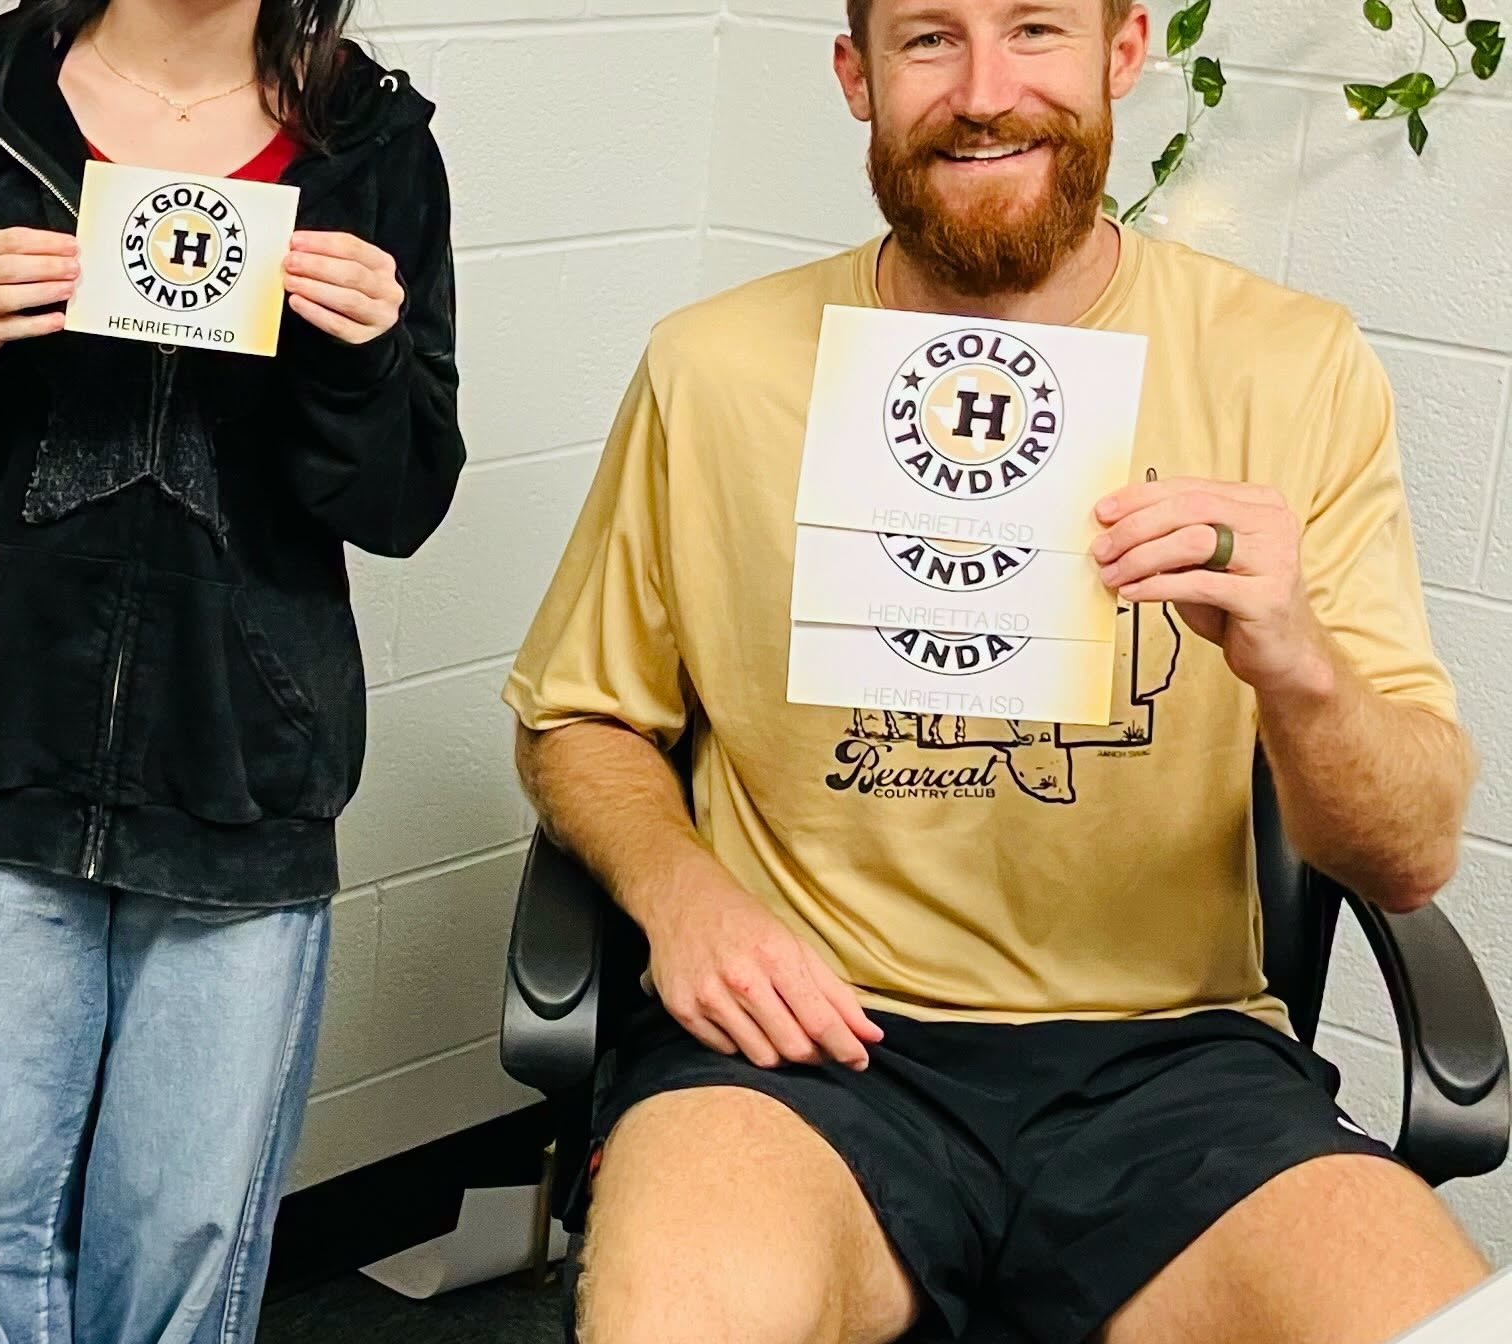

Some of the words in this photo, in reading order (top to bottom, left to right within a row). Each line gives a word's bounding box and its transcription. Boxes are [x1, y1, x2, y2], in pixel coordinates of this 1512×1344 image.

[151, 188, 228, 222] GOLD
[169, 228, 211, 269] H
[125, 233, 243, 309] STANDARD
[108, 315, 204, 341] HENRIETTA
[207, 327, 236, 344] ISD
[925, 334, 1037, 379] GOLD
[951, 390, 1011, 442] H
[890, 398, 1057, 495] STANDARD
[872, 506, 994, 539] HENRIETTA
[998, 523, 1034, 544] ISD
[867, 603, 989, 633] HENRIETTA
[994, 613, 1030, 634] ISD
[862, 686, 985, 714] HENRIETTA
[989, 696, 1025, 716] ISD
[826, 738, 1000, 794] Bearcat
[873, 787, 948, 800] COUNTRY
[953, 787, 996, 799] CLUB
